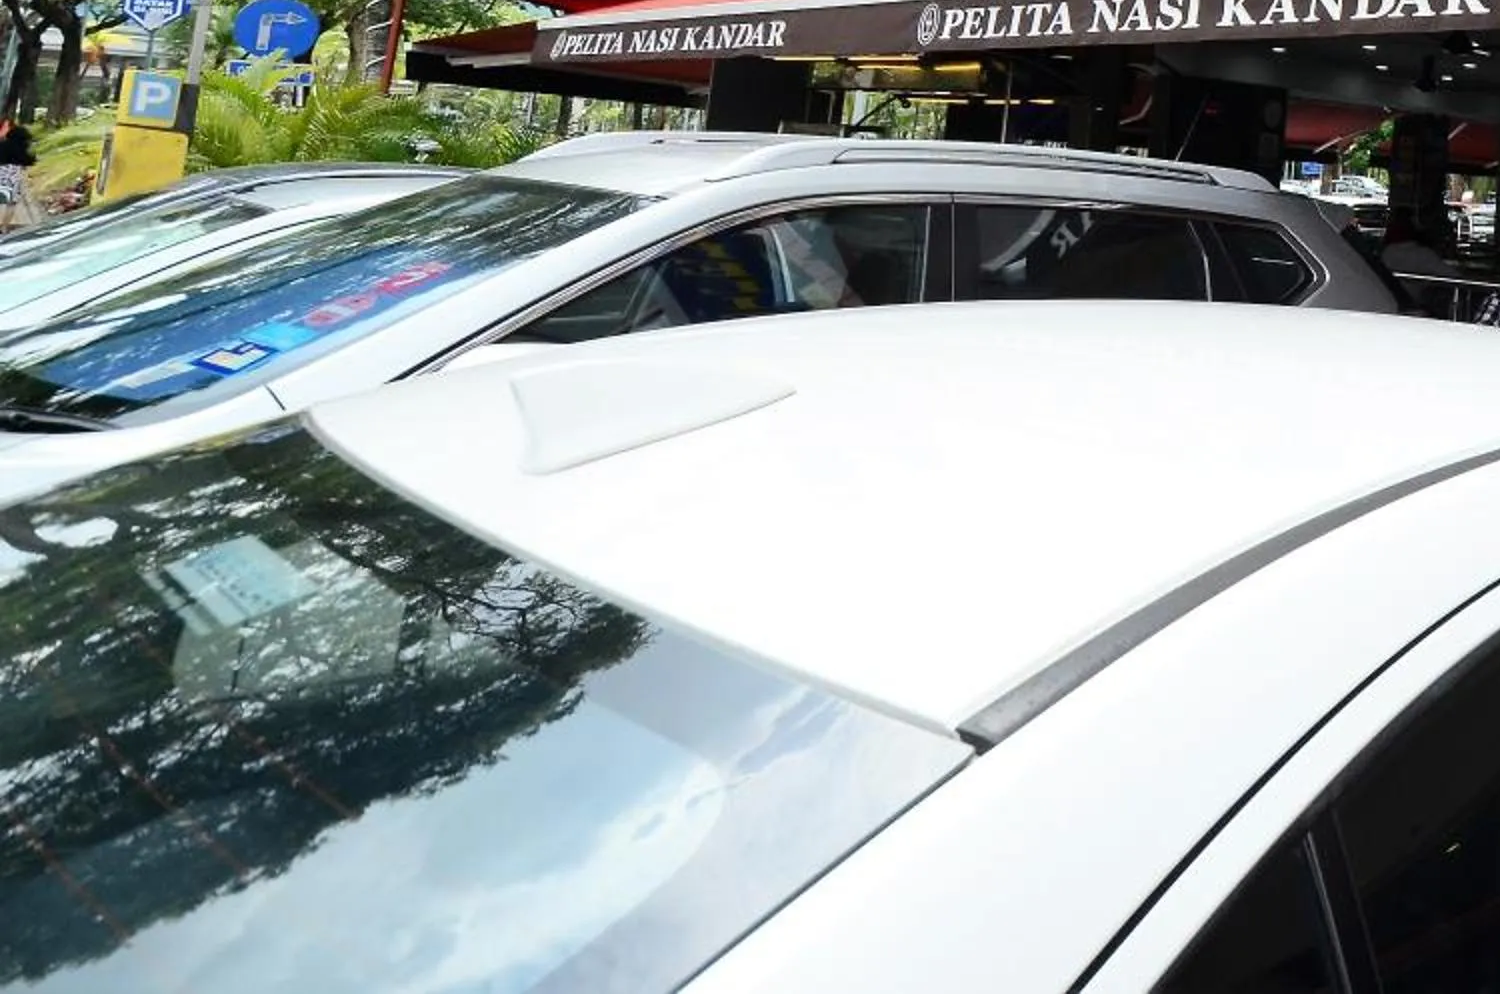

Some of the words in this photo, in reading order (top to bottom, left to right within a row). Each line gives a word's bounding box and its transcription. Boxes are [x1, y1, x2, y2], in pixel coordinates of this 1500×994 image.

[561, 31, 625, 56] PELITA
[627, 27, 680, 53] NASI
[682, 20, 787, 50] KANDAR
[939, 2, 1074, 41] PELITA
[134, 81, 172, 112] P
